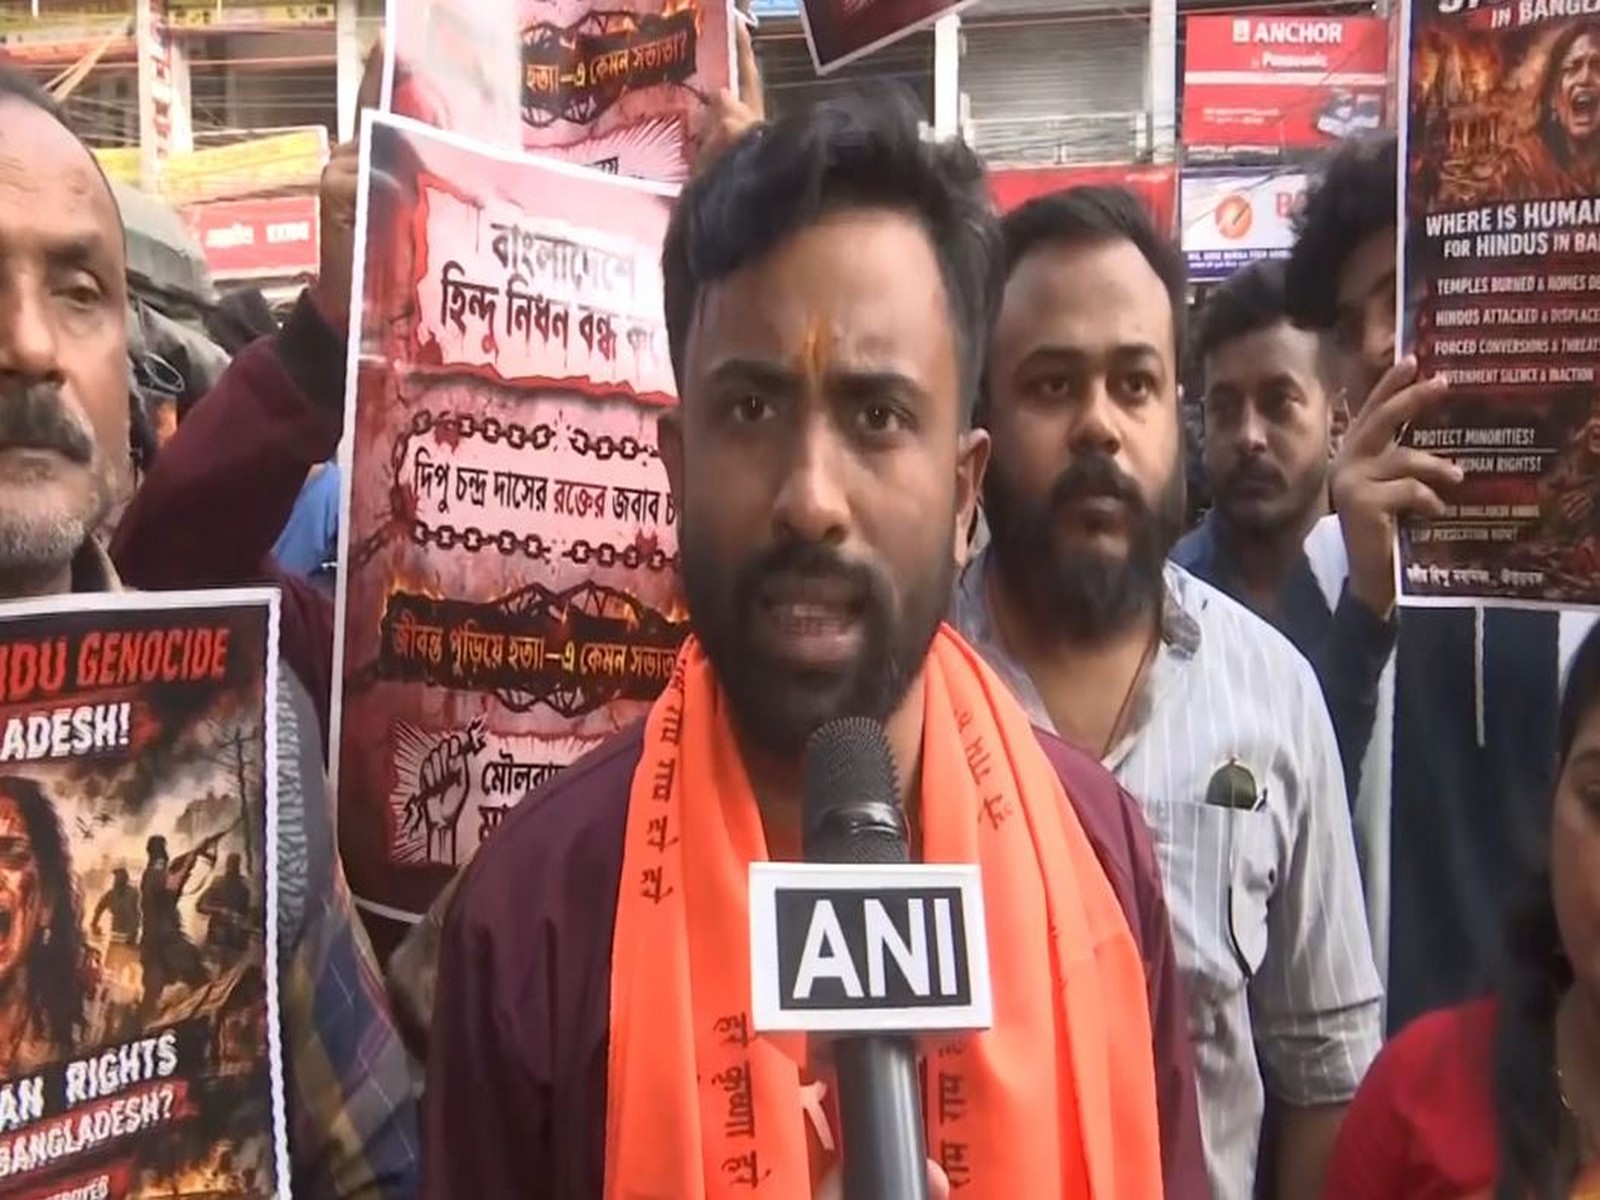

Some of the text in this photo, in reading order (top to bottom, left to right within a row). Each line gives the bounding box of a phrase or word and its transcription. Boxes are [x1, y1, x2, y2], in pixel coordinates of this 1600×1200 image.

[1490, 0, 1600, 29] IN BANGL
[1254, 22, 1342, 43] ANCHOR
[1426, 207, 1492, 237] WHERE
[1498, 204, 1517, 229] IS
[1444, 231, 1600, 258] FOR HINDUS IN BA
[1437, 276, 1489, 295] TEMPLES
[1491, 274, 1535, 294] BURNED
[440, 260, 500, 358] হিন্দু
[506, 273, 569, 350] নিধন
[577, 303, 620, 361] বন্ধ
[1435, 309, 1480, 326] HINDUS
[1482, 308, 1538, 325] ATTACKED
[1550, 308, 1600, 324] DISPLACE
[1435, 340, 1477, 355] FORCED
[1479, 338, 1549, 354] CONVERSIONS
[1500, 369, 1538, 383] SILENCE
[1549, 368, 1594, 382] INACTION
[1413, 429, 1535, 446] PROTECT MINORITIES!
[1497, 457, 1541, 473] RIGHTS!
[414, 446, 450, 513] দিপু
[456, 467, 489, 508] চন্দ্র
[493, 470, 549, 513] দাসের
[554, 480, 608, 519] রক্তের
[612, 486, 661, 525] জবাব
[77, 627, 230, 688] GENOCIDE
[581, 642, 627, 676] কেমন
[0, 702, 130, 762] ADESH!
[792, 898, 958, 999] ANI
[66, 1033, 178, 1103] RIGHTS
